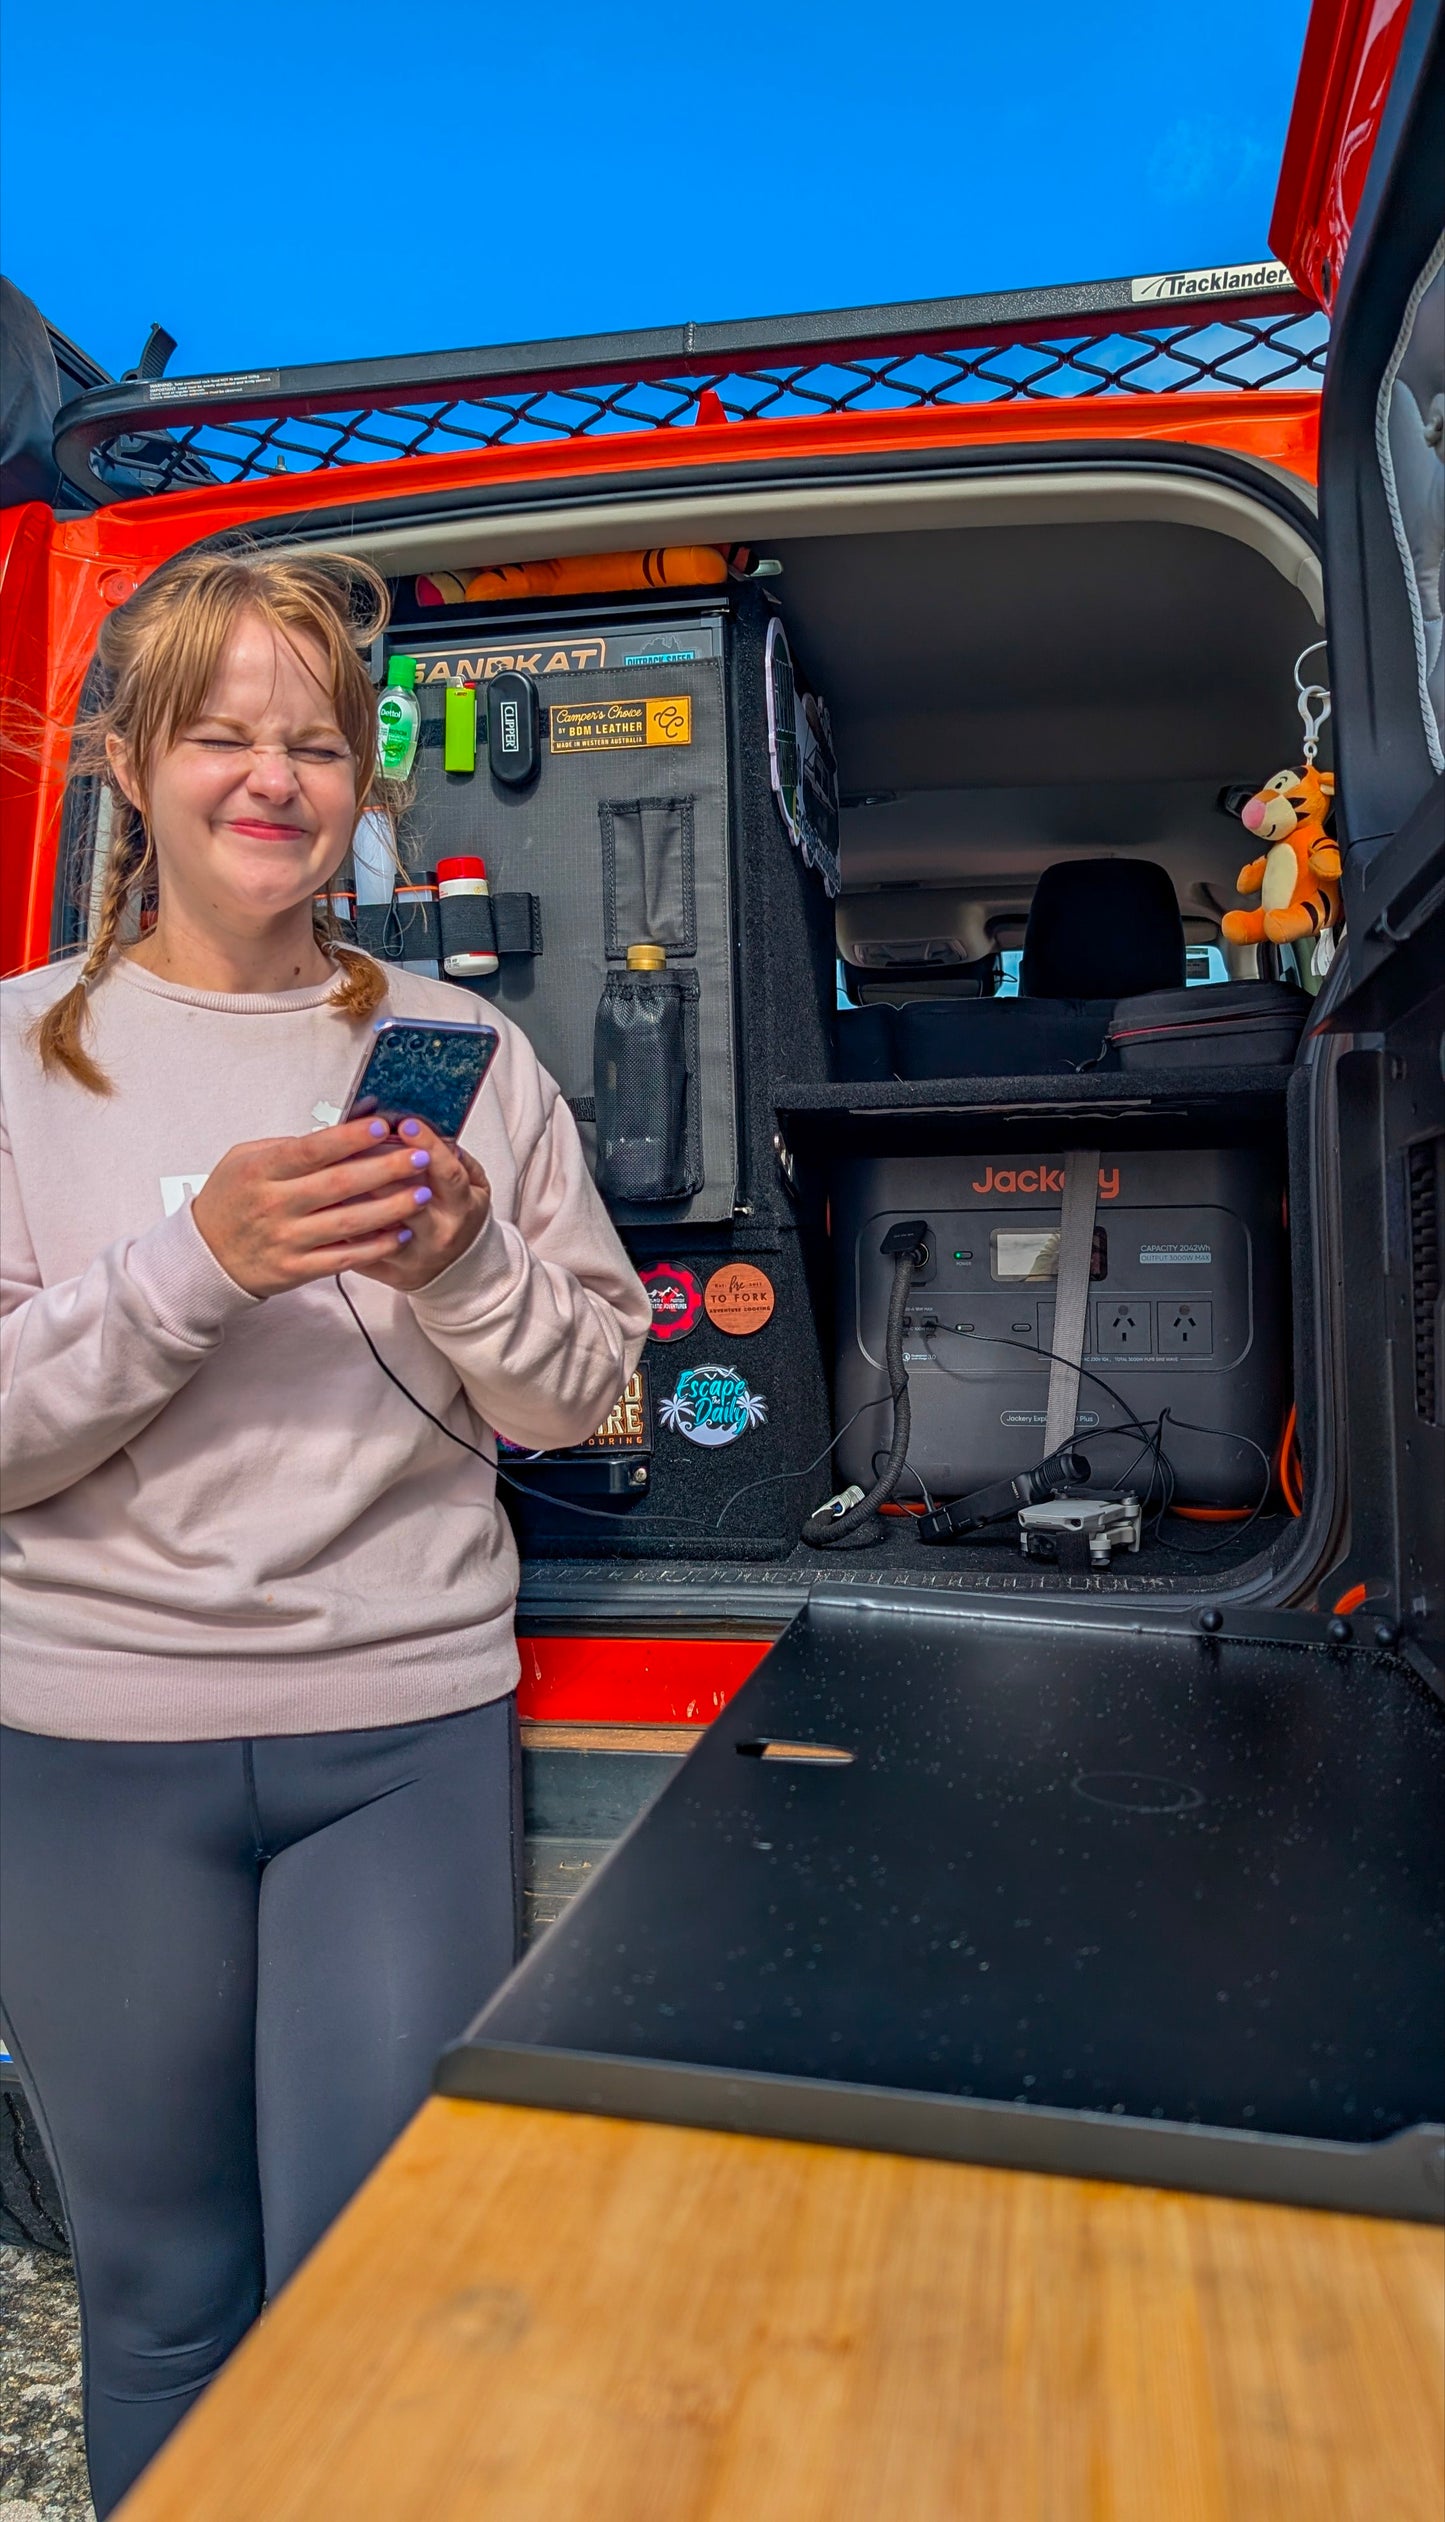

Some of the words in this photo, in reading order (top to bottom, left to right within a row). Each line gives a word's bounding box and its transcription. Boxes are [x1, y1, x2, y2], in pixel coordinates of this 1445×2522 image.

[1164, 267, 1287, 296] Tracklander
[380, 707, 401, 719] Dettol
[556, 709, 605, 724] Camper's
[607, 705, 643, 719] Choice
[504, 706, 516, 747] CLIPPER
[569, 725, 592, 737] BDM
[595, 721, 643, 735] LEATHER
[556, 741, 572, 749] MADE
[582, 738, 609, 747] WESTERN
[610, 736, 643, 745] AUSTRALIA
[972, 1165, 1120, 1199] Jacky
[1140, 1244, 1178, 1252] CAPACITY
[1141, 1254, 1168, 1262] OUTPUT
[1195, 1254, 1210, 1262] MAX
[710, 1294, 727, 1303] TO
[734, 1292, 768, 1303] FORK
[677, 1369, 747, 1400] Escape
[694, 1399, 747, 1435] Daily
[1006, 1414, 1034, 1424] Jackery
[1079, 1414, 1094, 1423] Plus
